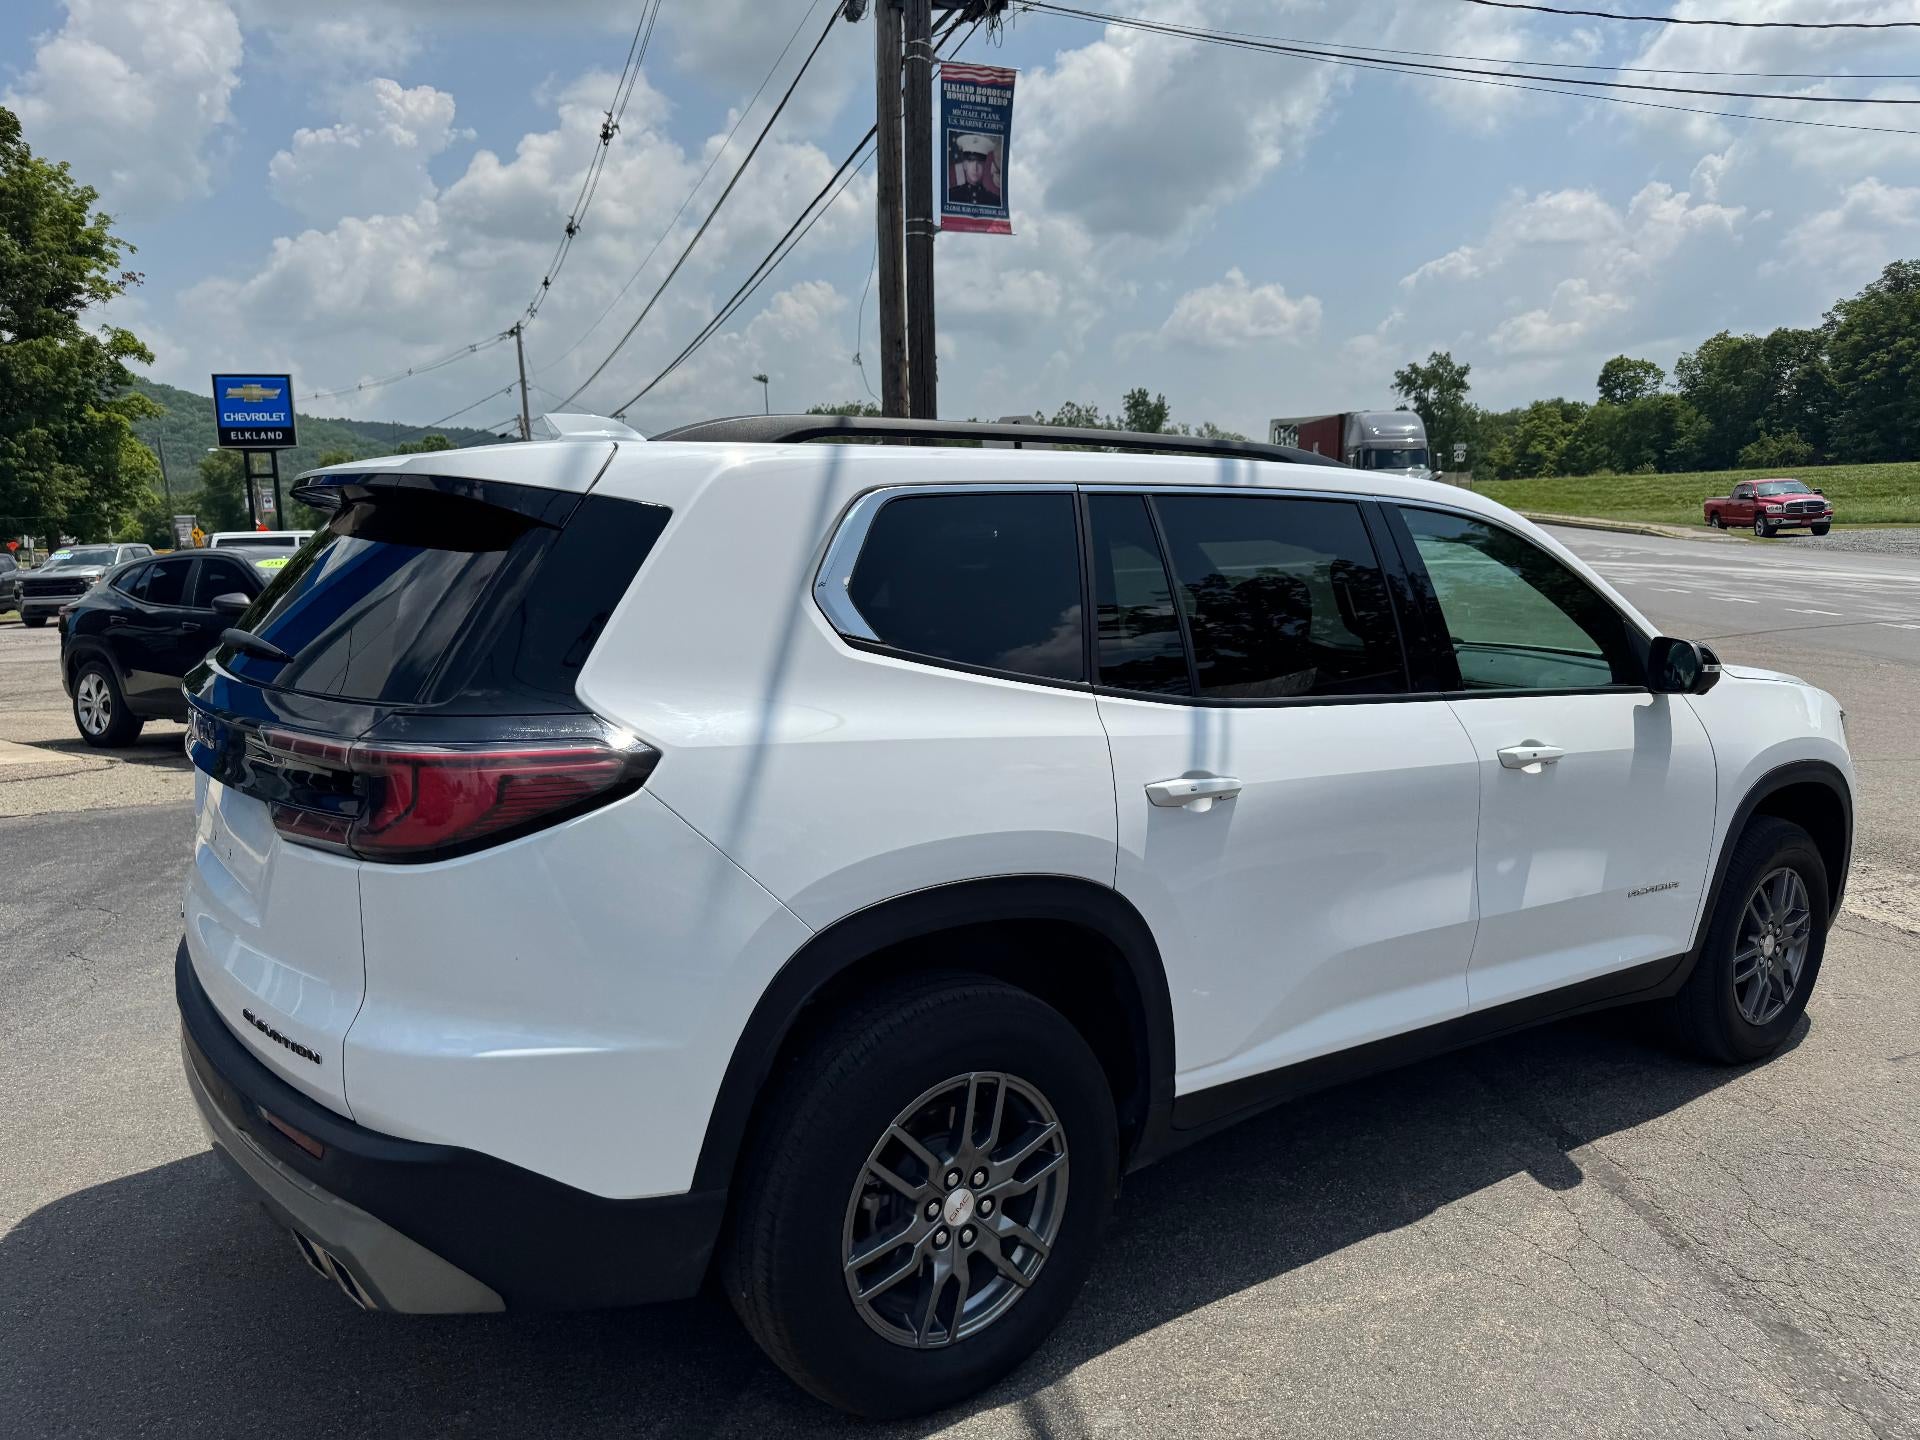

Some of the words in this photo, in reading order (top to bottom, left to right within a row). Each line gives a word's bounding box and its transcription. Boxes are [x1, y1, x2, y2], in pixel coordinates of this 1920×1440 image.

[943, 82, 975, 94] ELKLAND
[976, 86, 1012, 99] BOROUGH
[946, 91, 987, 104] HOMETOWN
[988, 96, 1008, 106] HERO
[952, 108, 979, 119] MICHAEL
[980, 112, 1001, 121] PLANK
[960, 117, 984, 129] MARINE
[984, 121, 1005, 131] CORPS
[223, 412, 286, 422] CHEVROLET
[230, 431, 283, 440] ELKLAND
[242, 1008, 322, 1065] ELEVATION
[949, 1193, 971, 1222] GMC
